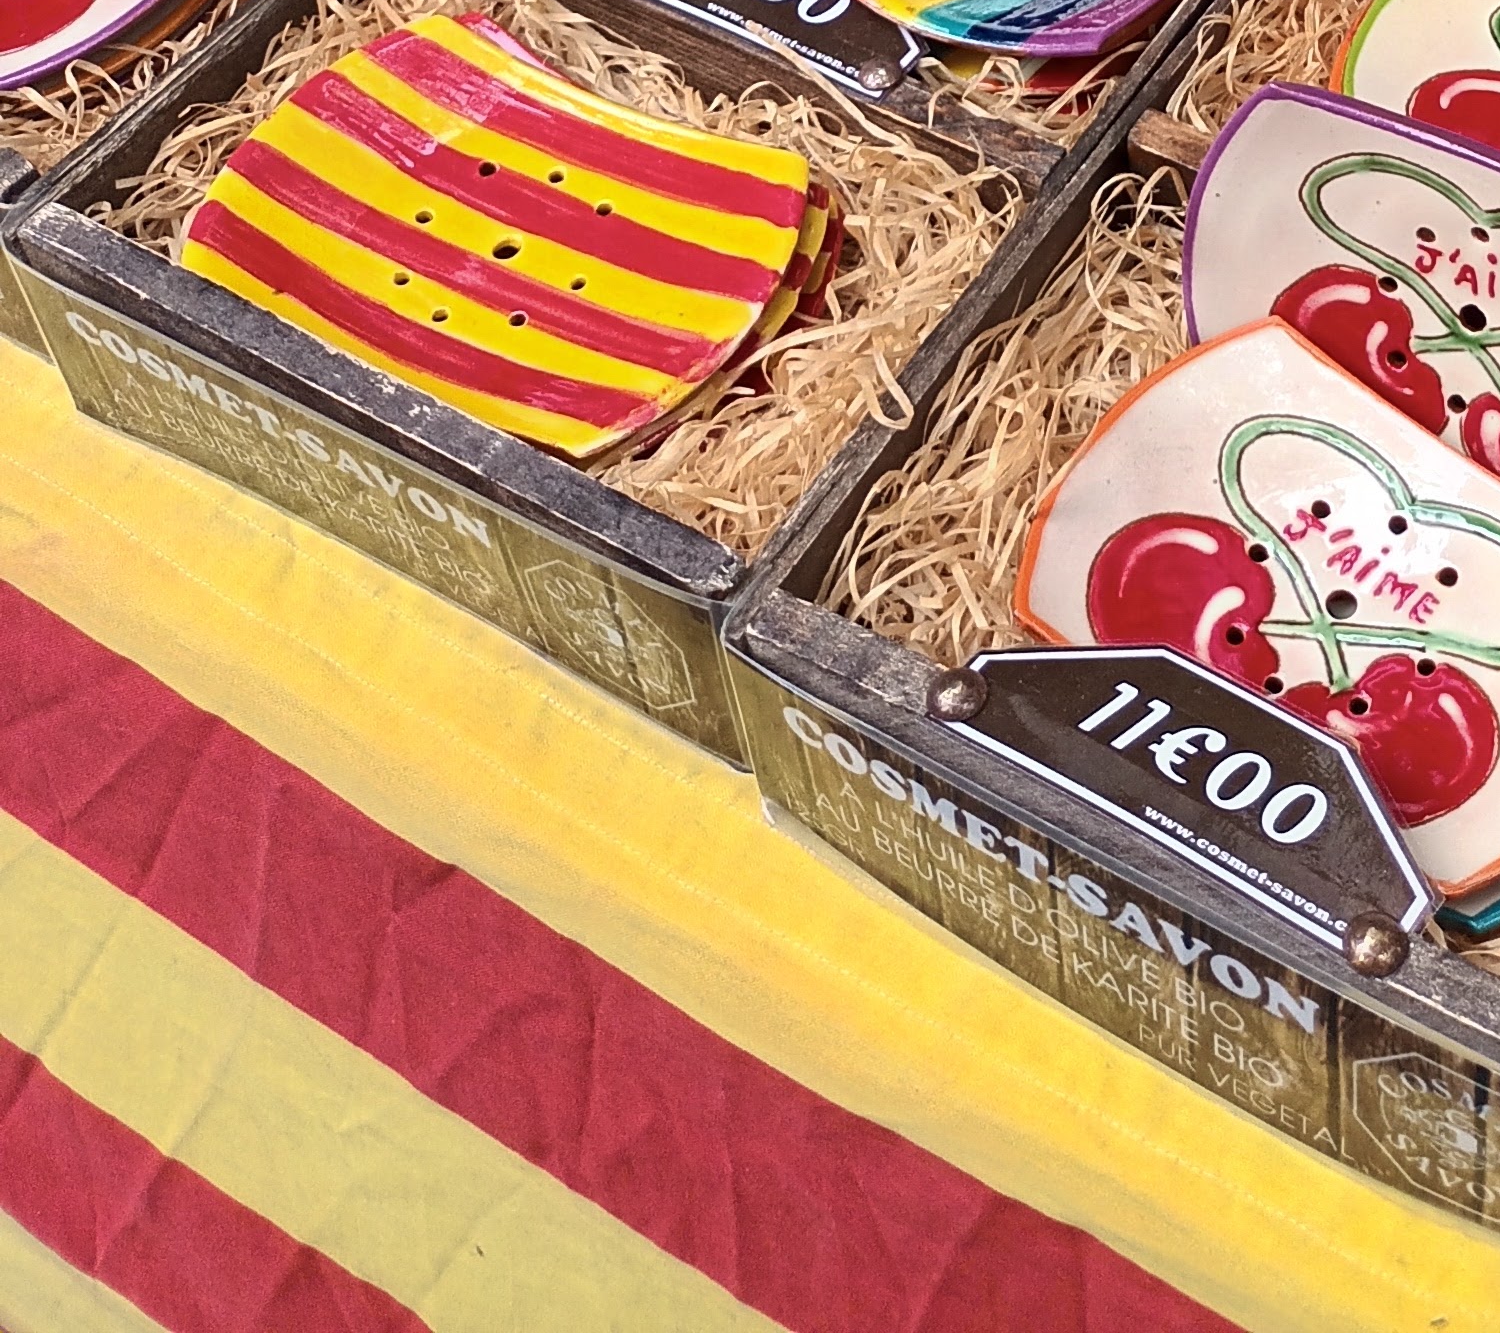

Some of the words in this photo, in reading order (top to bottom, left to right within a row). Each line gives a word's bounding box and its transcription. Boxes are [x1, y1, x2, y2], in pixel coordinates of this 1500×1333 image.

[65, 311, 492, 549] COSMET-SAVON
[782, 706, 1320, 1034] COSMET-SAVON
[1077, 680, 1328, 844] 11€00
[815, 793, 861, 833] AU
[871, 825, 1000, 928] BEURRE
[1011, 914, 1060, 964] DE
[1073, 951, 1200, 1046] KARITE
[1213, 1032, 1284, 1088] BIO
[874, 800, 996, 893] L'HUILE
[1008, 882, 1161, 991] D'OLIVE
[1174, 976, 1245, 1033] BIO
[1138, 1022, 1198, 1072] PUR
[1207, 1062, 1355, 1161] VEGETAL
